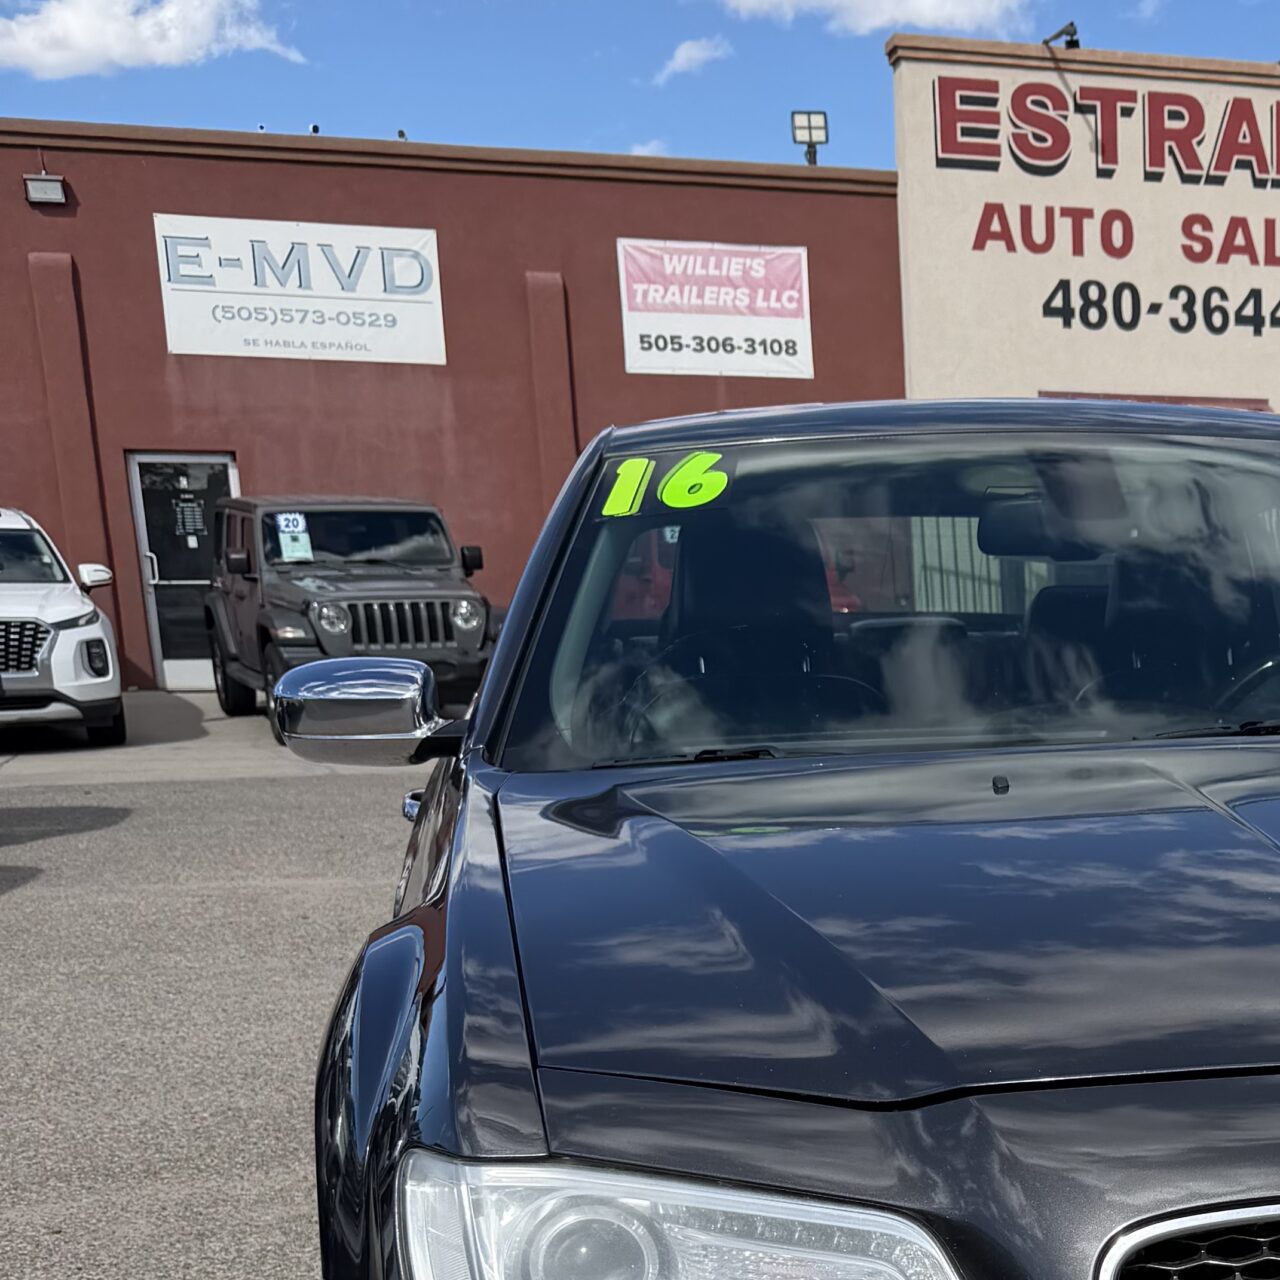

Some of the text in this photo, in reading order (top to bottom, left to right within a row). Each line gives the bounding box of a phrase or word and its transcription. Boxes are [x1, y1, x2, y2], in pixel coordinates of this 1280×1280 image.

[971, 201, 1135, 260] AUTO
[162, 234, 435, 296] E-MVD
[662, 253, 766, 278] WILLIE'S
[632, 282, 799, 309] TRAILERS LLC
[211, 304, 398, 329] (505)573-0529
[243, 337, 261, 348] SE
[264, 339, 307, 349] HABLA
[639, 333, 798, 356] 505-306-3108
[602, 451, 729, 517] 16
[283, 517, 300, 529] 20
